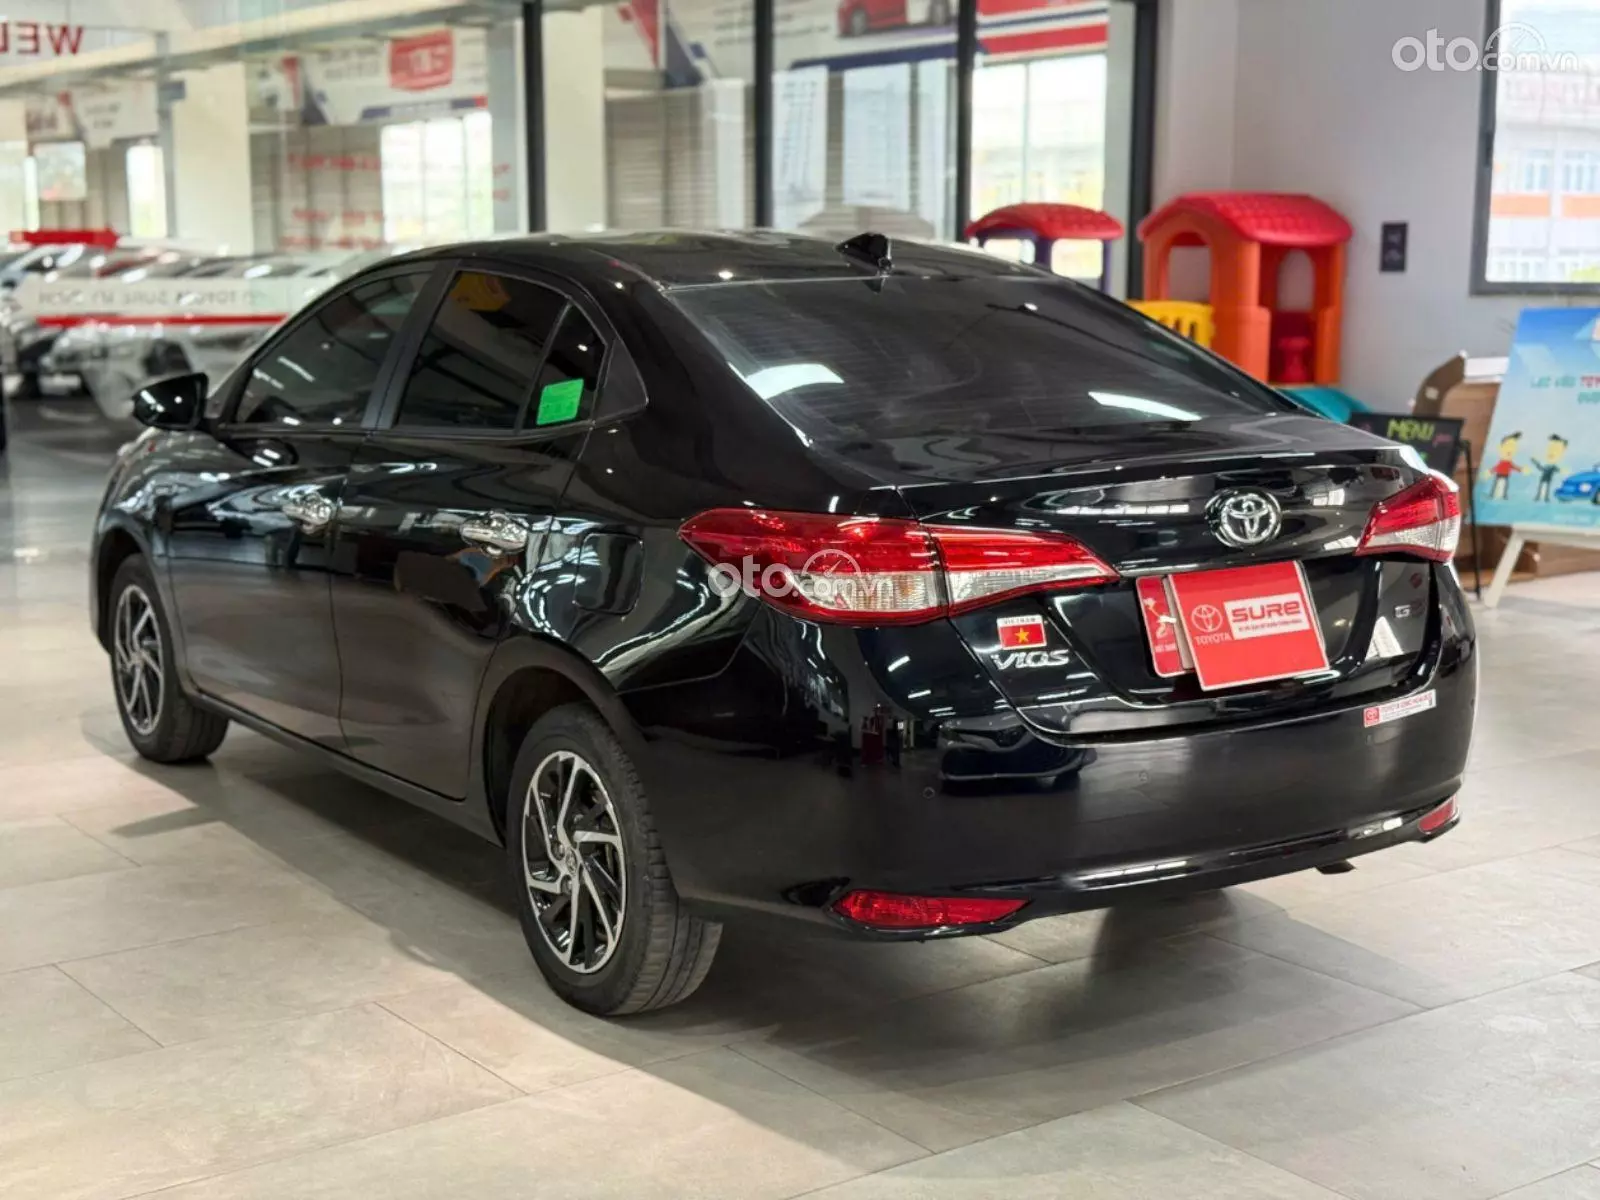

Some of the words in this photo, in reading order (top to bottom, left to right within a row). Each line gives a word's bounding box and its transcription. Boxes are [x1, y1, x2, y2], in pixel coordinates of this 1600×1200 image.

[1387, 418, 1435, 441] MENU
[1395, 604, 1411, 618] G
[1195, 631, 1232, 645] TOYOTA
